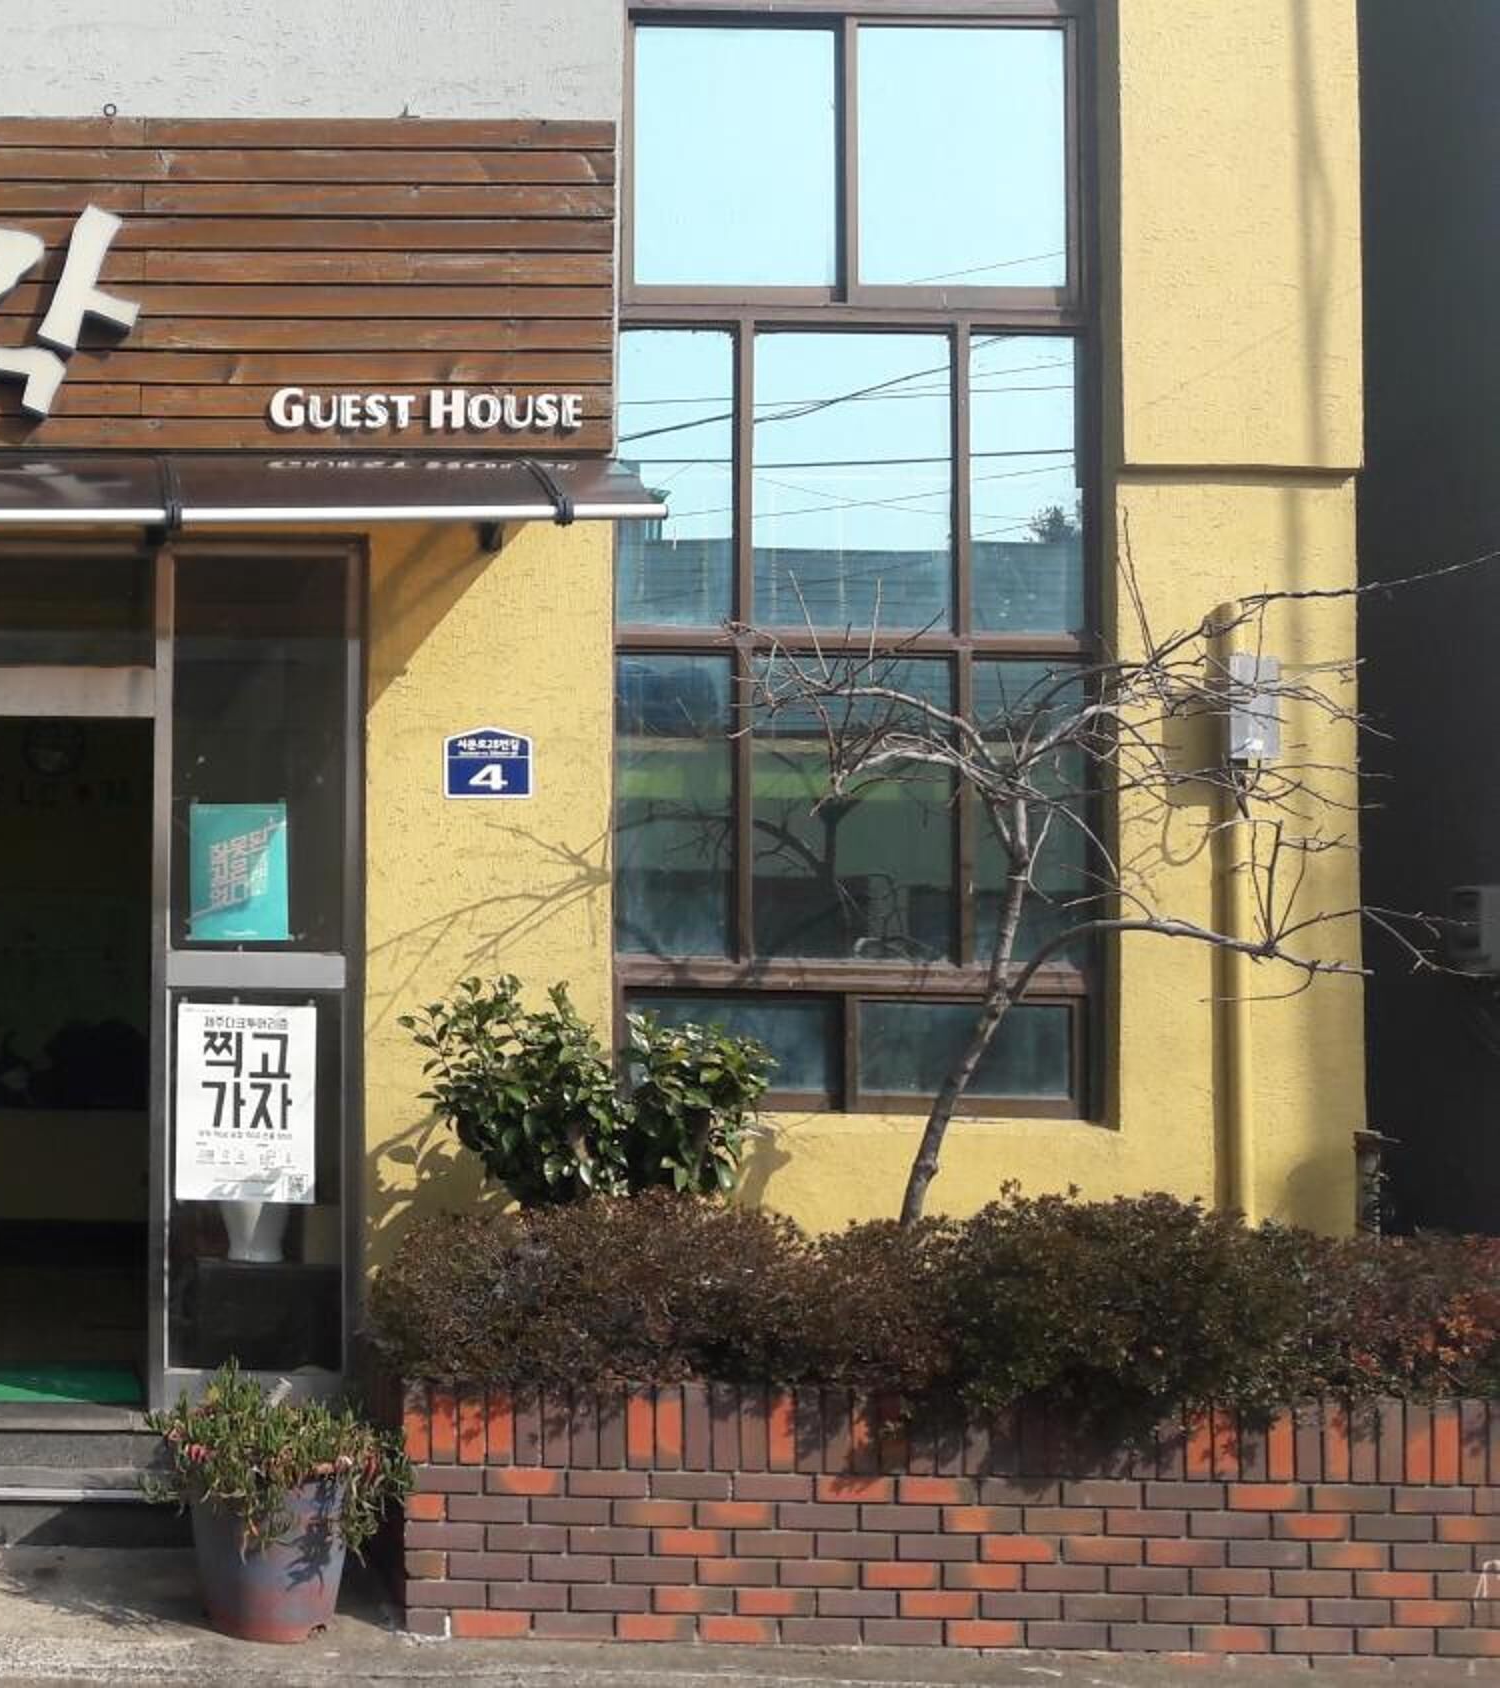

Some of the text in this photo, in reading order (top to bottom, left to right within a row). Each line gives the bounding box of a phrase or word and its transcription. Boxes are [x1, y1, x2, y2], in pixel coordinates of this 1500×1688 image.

[269, 387, 583, 428] GUEST HOUSE
[468, 763, 509, 791] 4
[203, 1031, 291, 1080] 찍고
[201, 1081, 292, 1130] 가자
